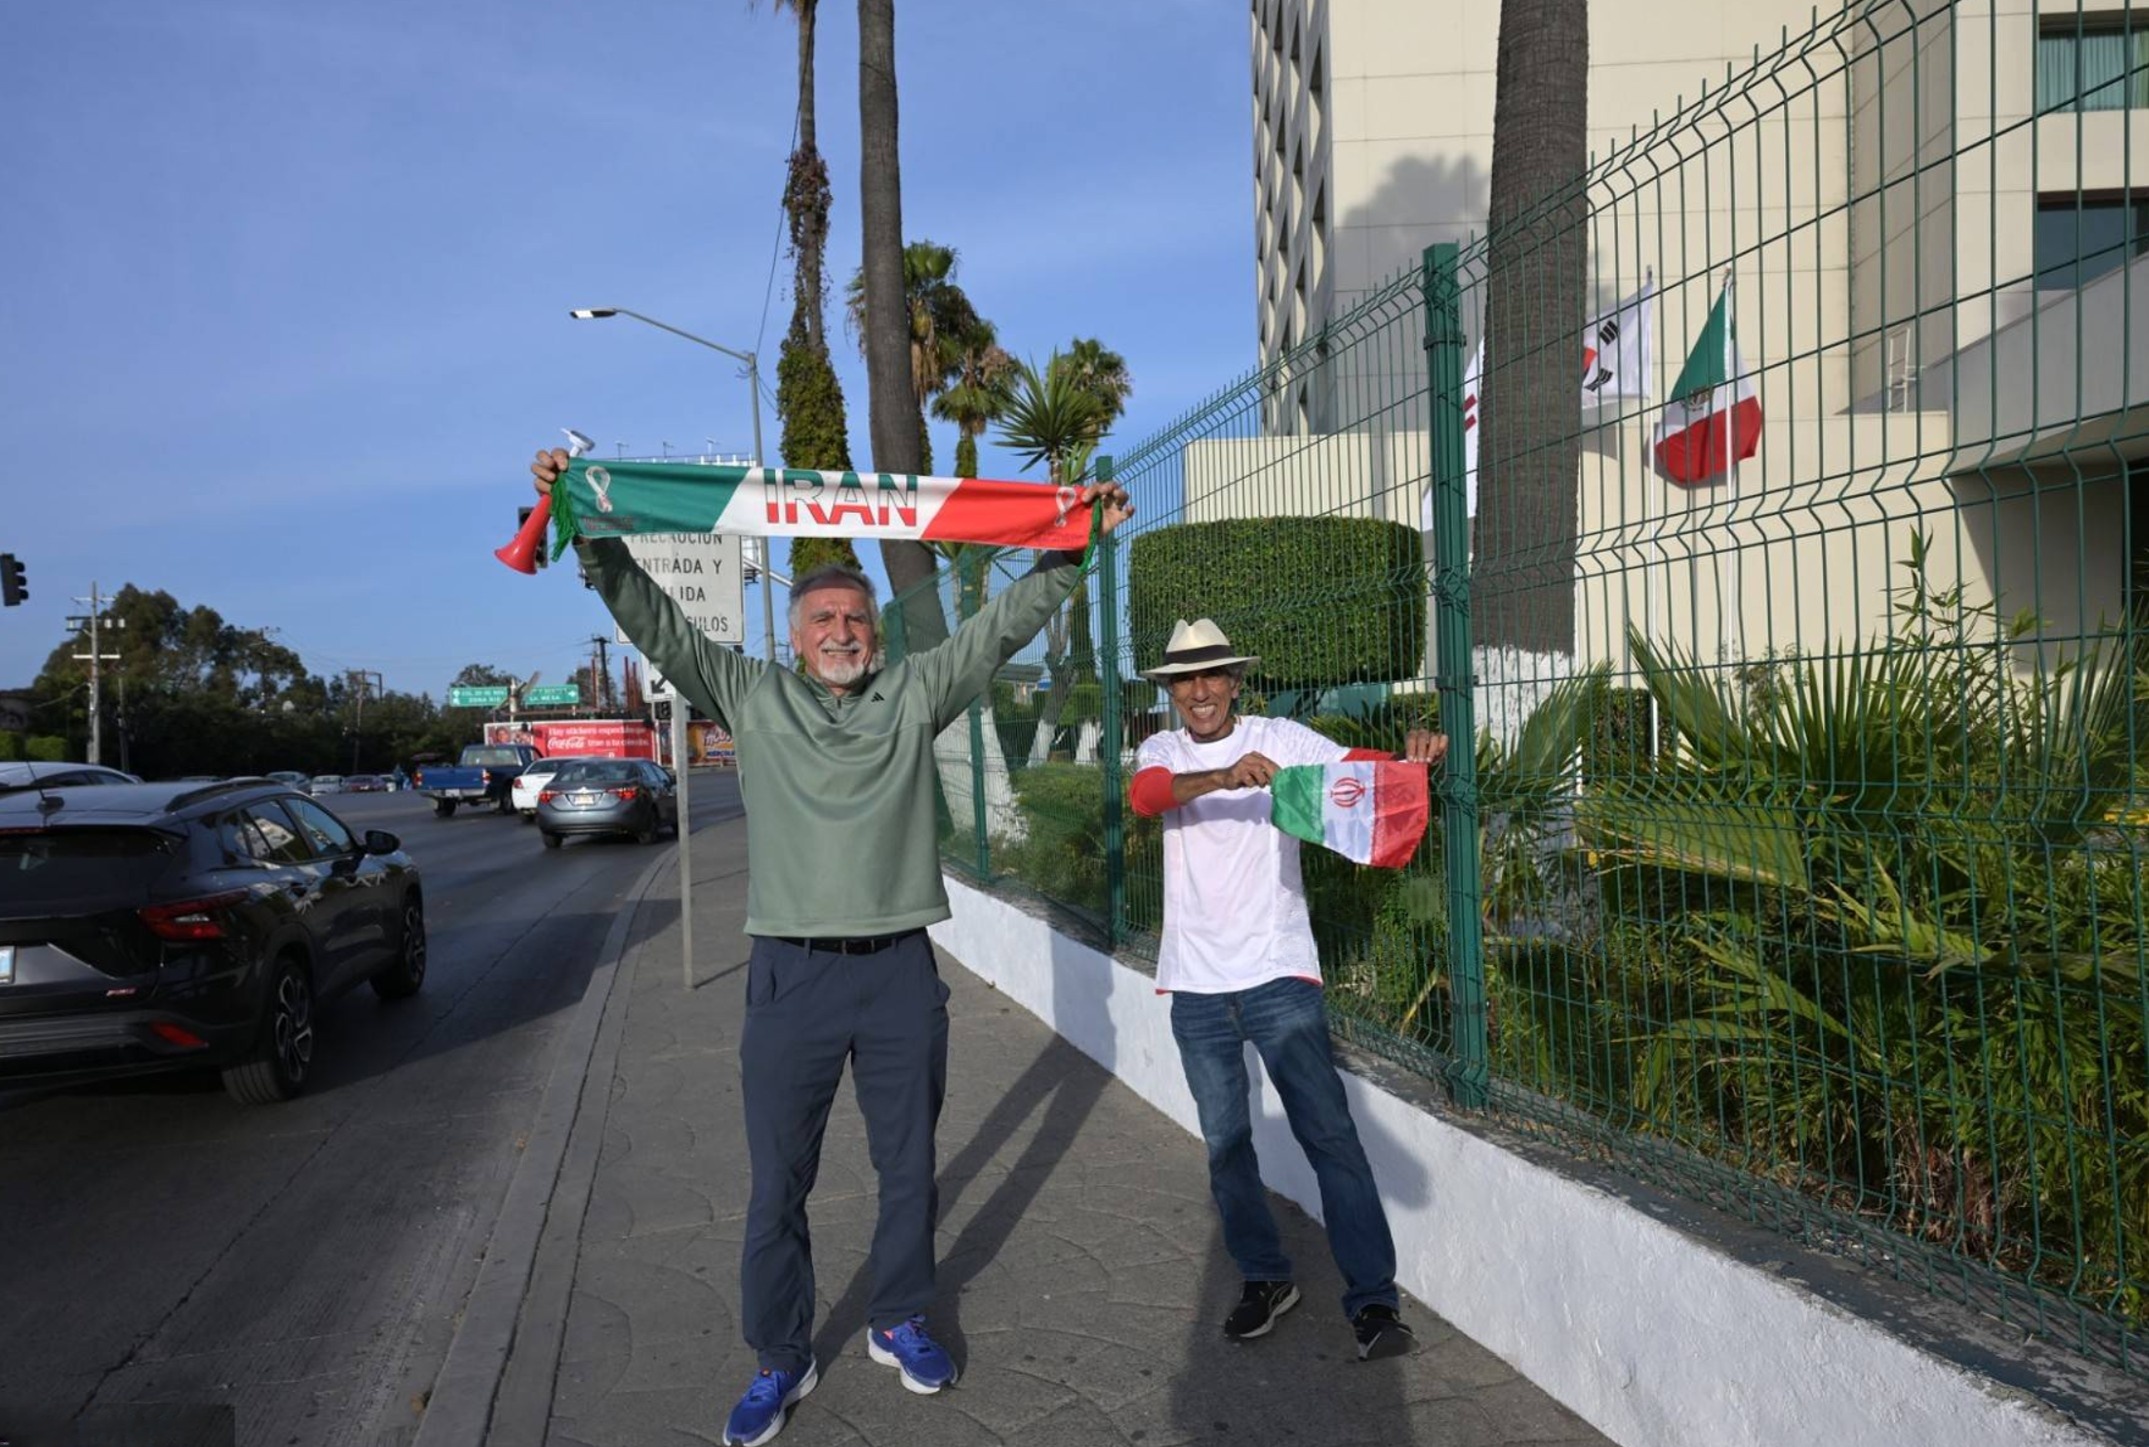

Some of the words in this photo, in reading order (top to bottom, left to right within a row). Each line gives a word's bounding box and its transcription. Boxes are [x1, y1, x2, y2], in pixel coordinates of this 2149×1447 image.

[763, 468, 918, 527] IRAN
[636, 557, 704, 575] NTRADA
[713, 558, 722, 575] Y
[547, 736, 585, 750] Coca-Cola
